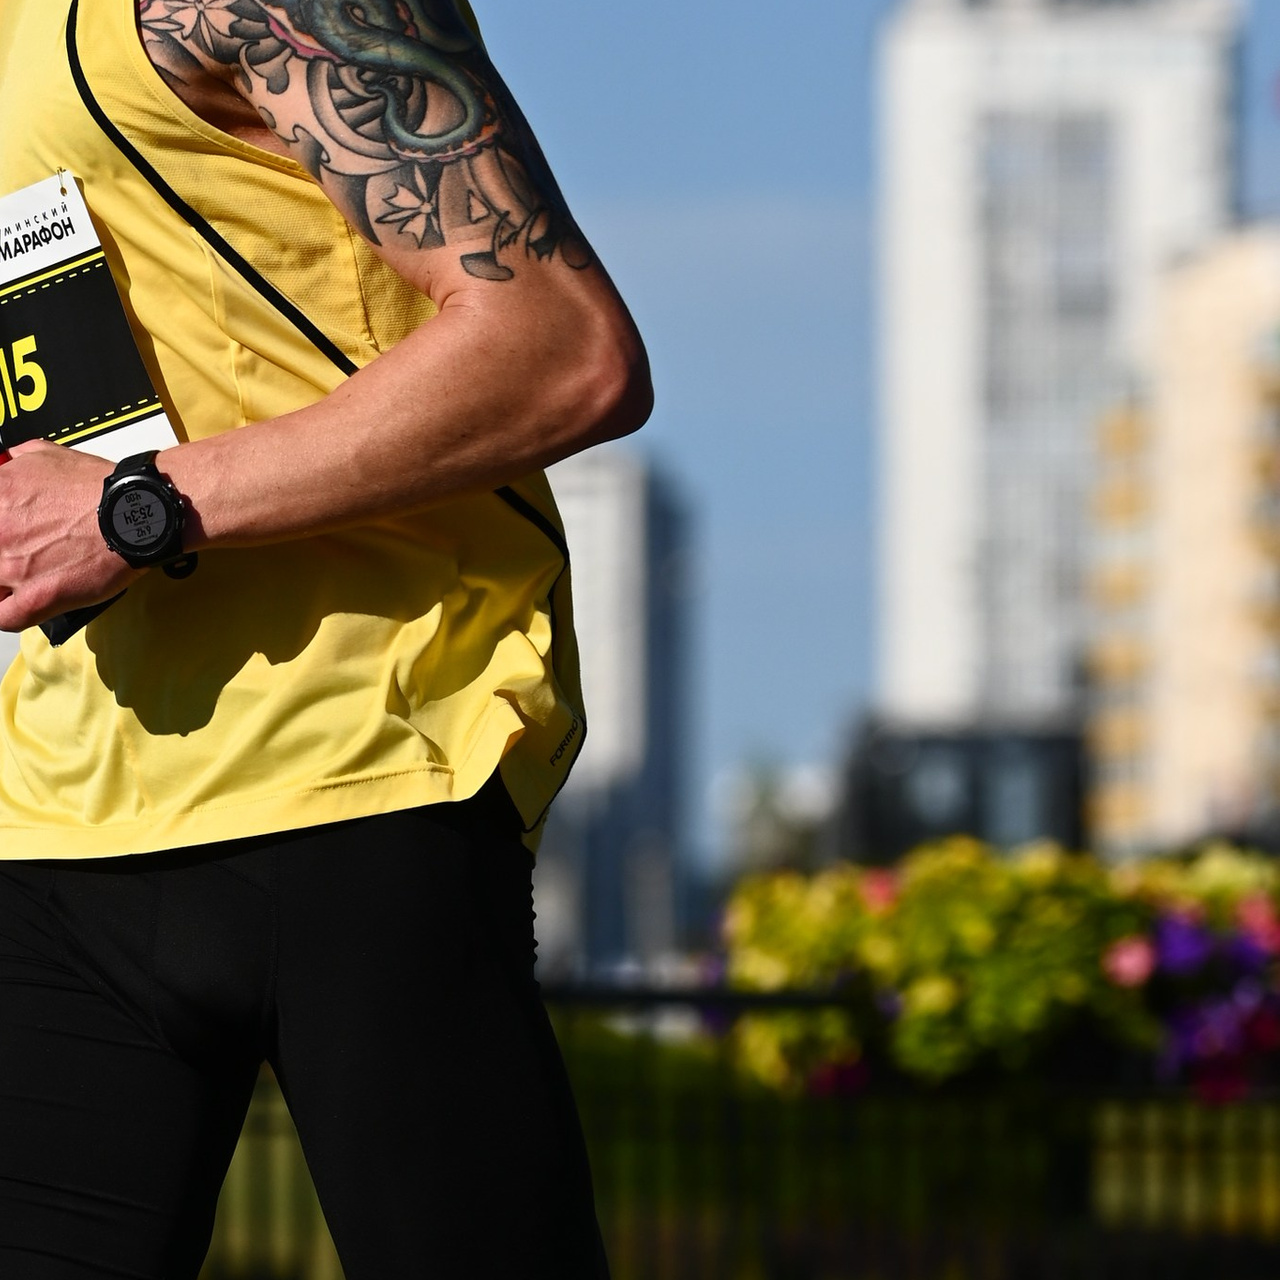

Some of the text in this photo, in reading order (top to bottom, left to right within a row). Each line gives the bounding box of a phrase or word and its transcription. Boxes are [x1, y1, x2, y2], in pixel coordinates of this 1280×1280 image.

[4, 201, 69, 237] МИНСКИЙ
[123, 504, 154, 525] 25:34
[550, 714, 578, 767] FORMO
